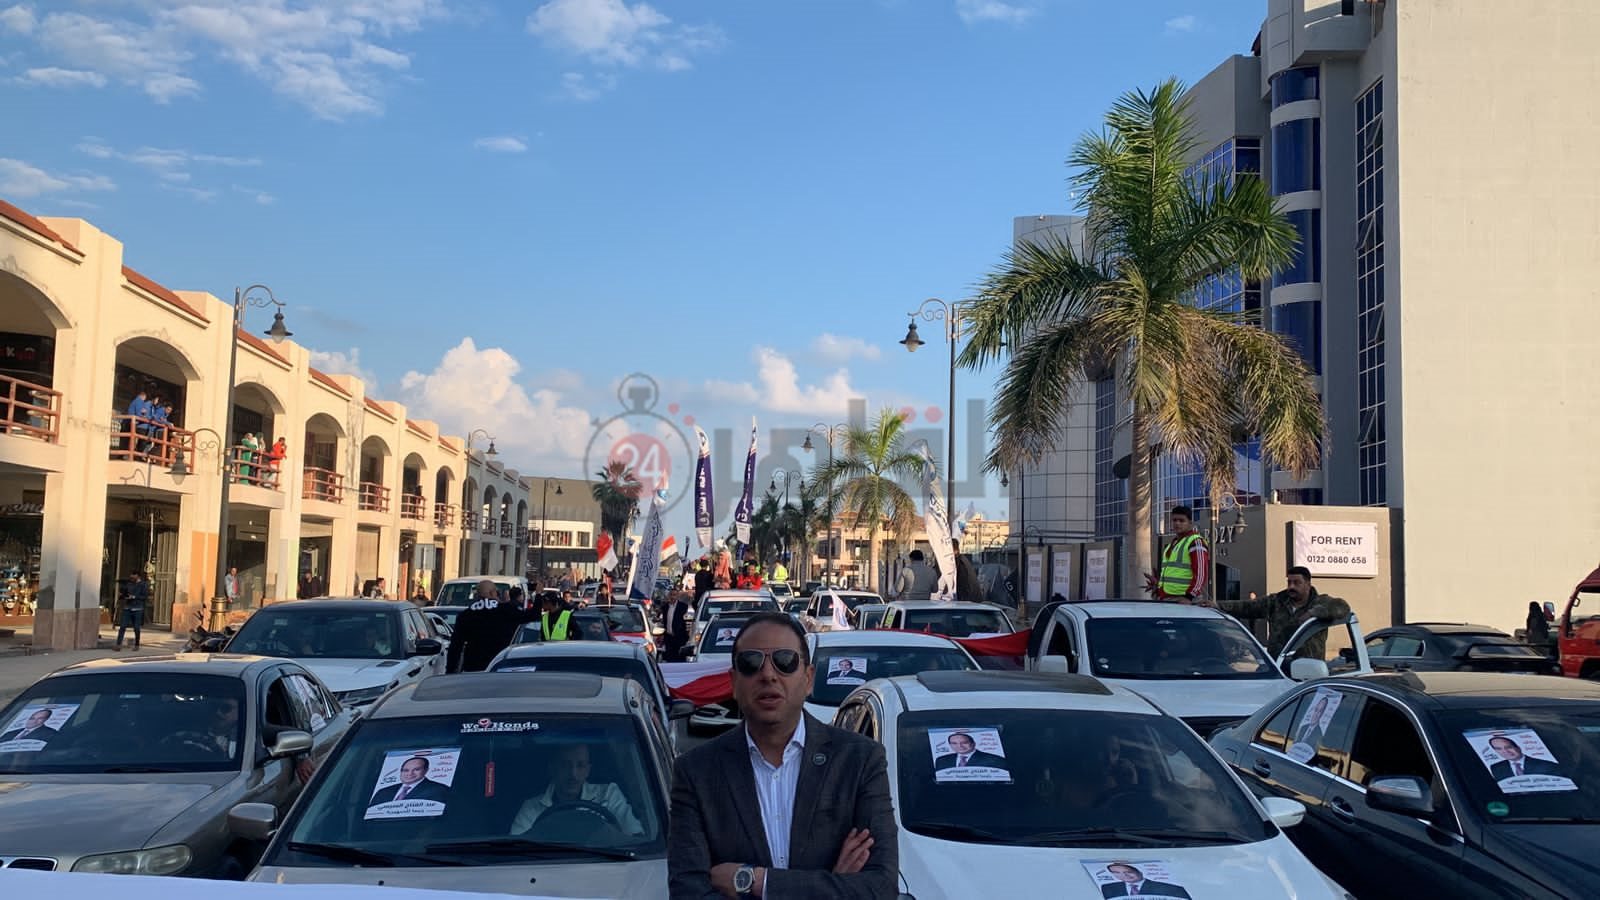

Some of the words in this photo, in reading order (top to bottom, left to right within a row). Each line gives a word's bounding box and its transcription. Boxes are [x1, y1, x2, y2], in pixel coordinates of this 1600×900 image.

[1311, 535, 1333, 545] FOR
[1335, 536, 1363, 546] RENT
[1306, 555, 1326, 563] 0122
[1327, 555, 1349, 564] 0880
[1351, 556, 1367, 564] 658
[492, 721, 540, 730] Honda
